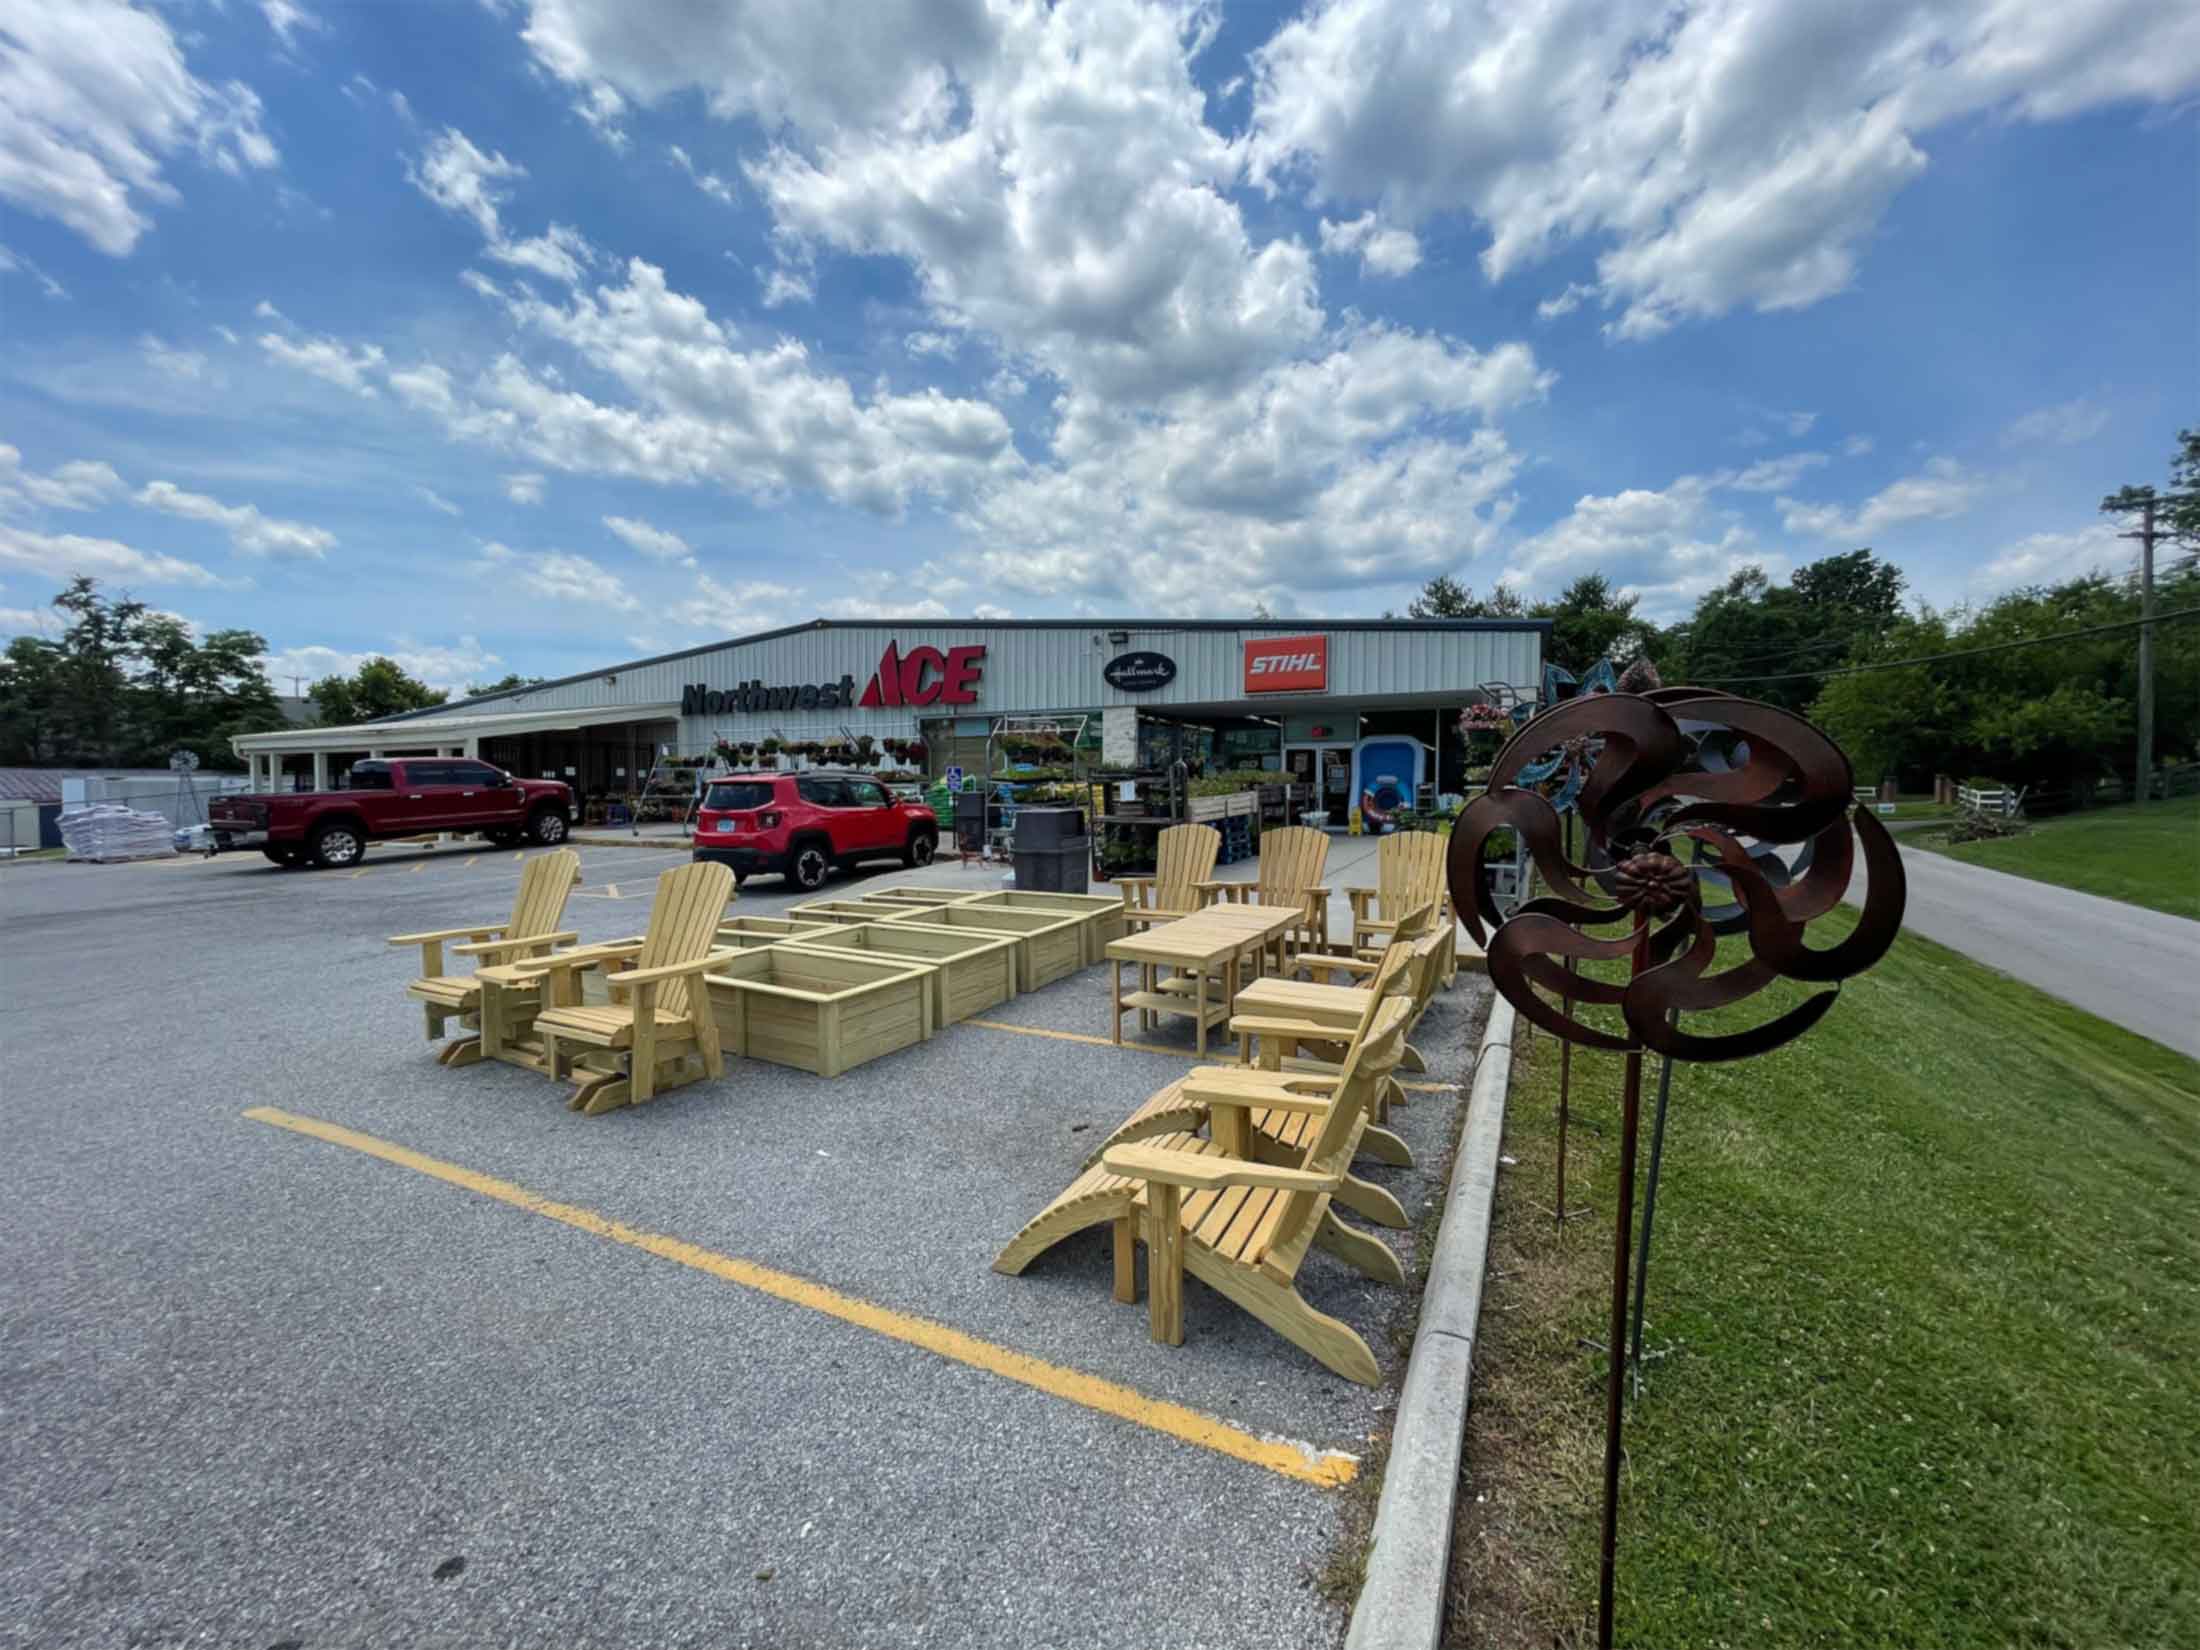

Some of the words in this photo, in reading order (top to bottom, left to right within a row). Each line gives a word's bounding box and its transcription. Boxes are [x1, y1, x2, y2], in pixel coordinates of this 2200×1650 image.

[682, 674, 855, 715] Northwest
[858, 639, 986, 706] ACE
[1249, 654, 1321, 674] STIHL
